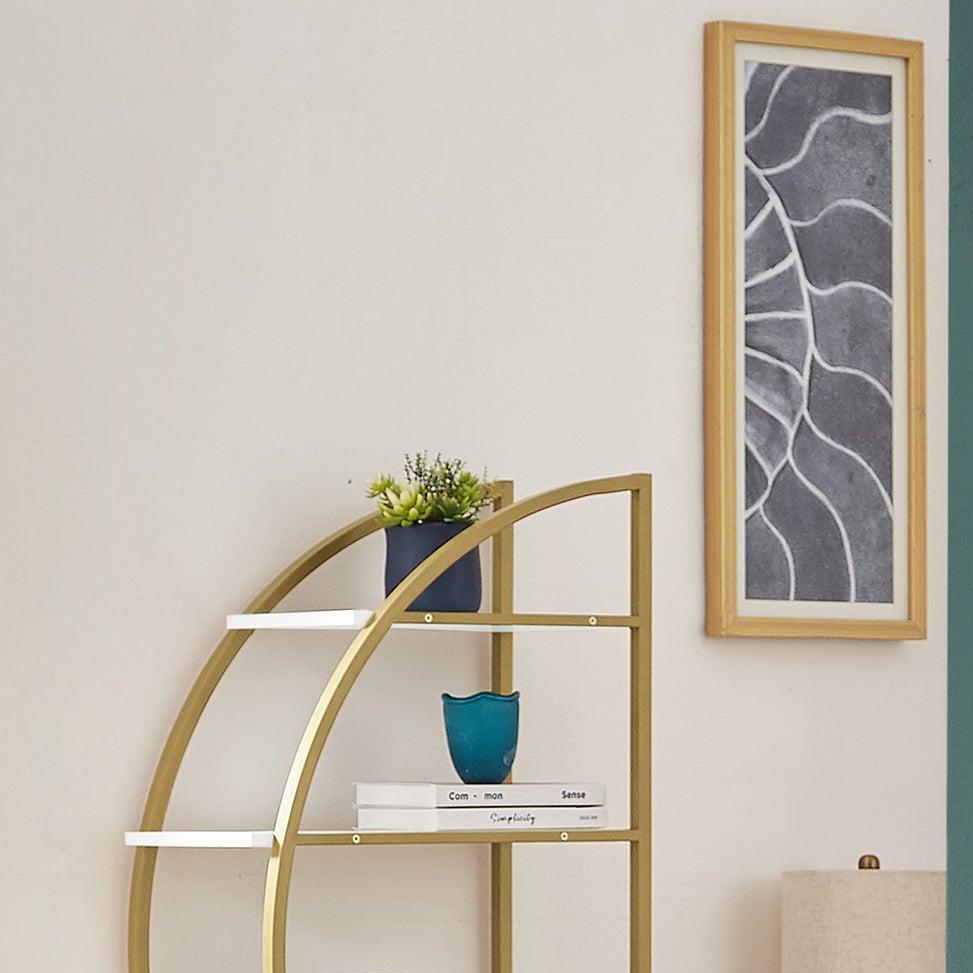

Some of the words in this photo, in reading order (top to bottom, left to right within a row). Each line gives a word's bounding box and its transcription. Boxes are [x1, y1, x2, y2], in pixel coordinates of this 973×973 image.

[448, 791, 469, 801] Com
[484, 792, 503, 800] mon
[561, 790, 586, 799] Sense
[489, 812, 536, 826] Simplicity
